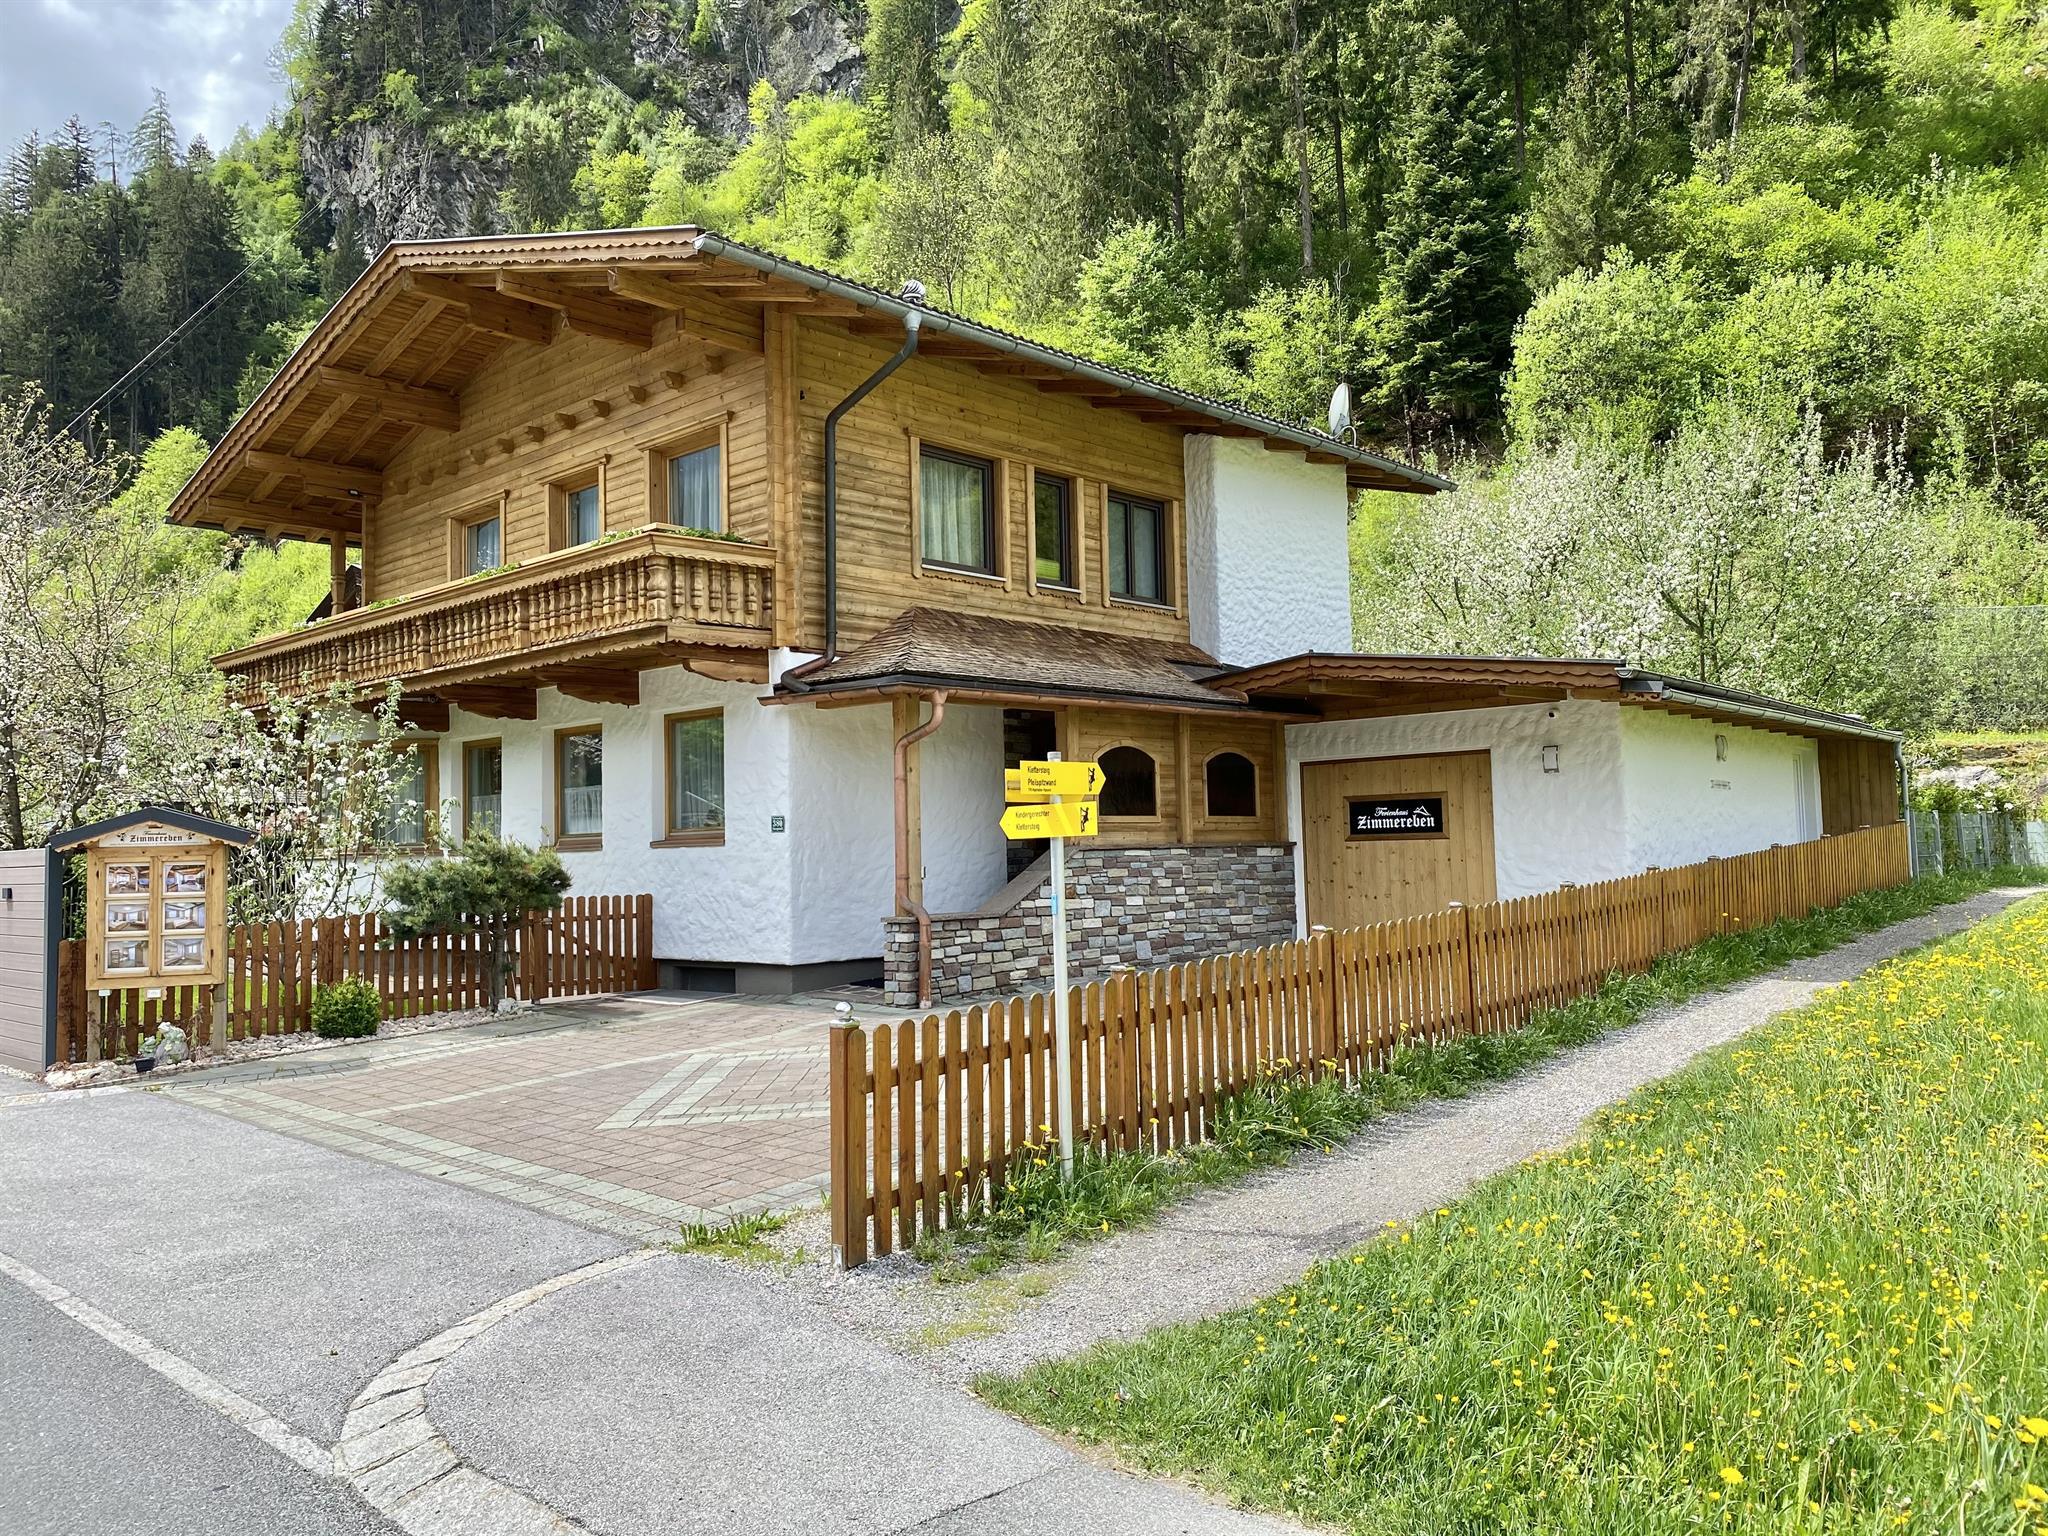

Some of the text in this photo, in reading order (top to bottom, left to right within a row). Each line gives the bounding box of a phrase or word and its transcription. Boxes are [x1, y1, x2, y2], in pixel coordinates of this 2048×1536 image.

[1027, 766, 1050, 775] Klettersteig
[1015, 810, 1050, 819] Kindergerechter
[1374, 806, 1409, 817] Ferienhaus
[1015, 823, 1040, 831] Klettersteig
[1357, 815, 1435, 830] Zimmereben
[130, 834, 183, 843] Zimmereben
